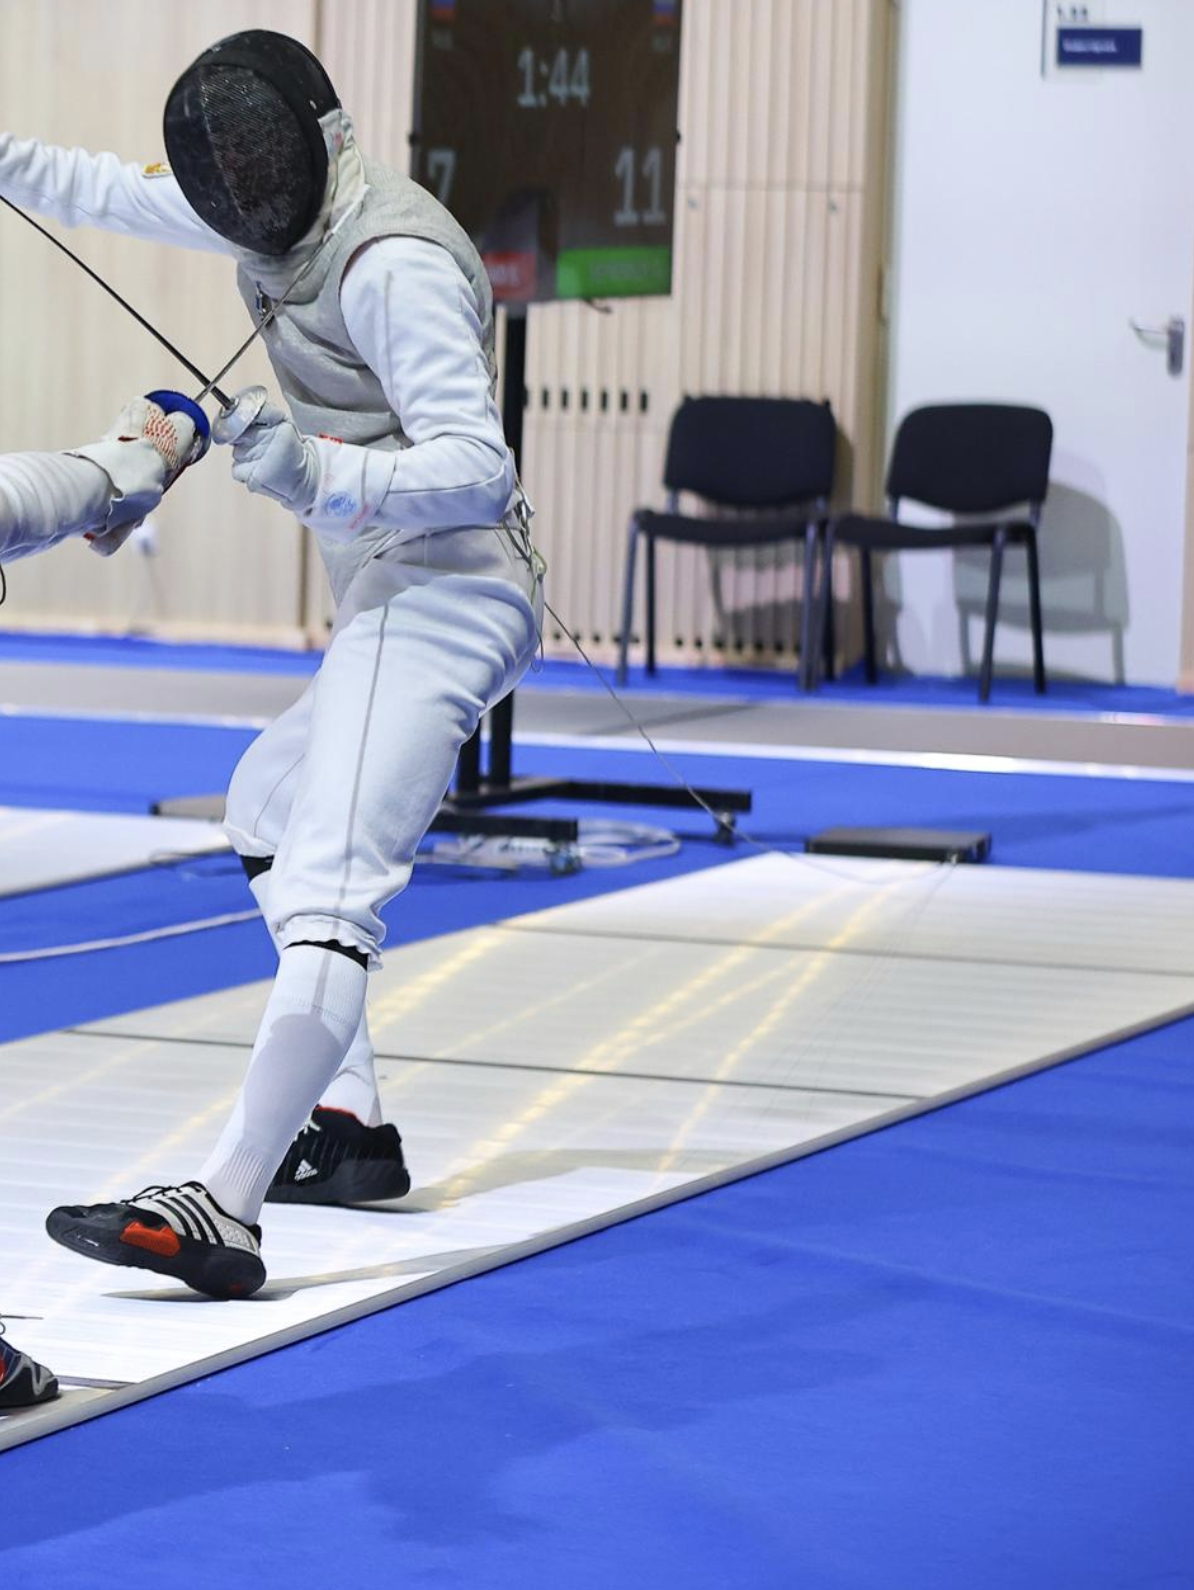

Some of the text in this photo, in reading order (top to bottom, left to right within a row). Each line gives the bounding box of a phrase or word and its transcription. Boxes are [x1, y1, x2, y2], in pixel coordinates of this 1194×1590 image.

[516, 46, 591, 107] 1:44
[427, 149, 456, 204] 7
[614, 147, 666, 226] 11
